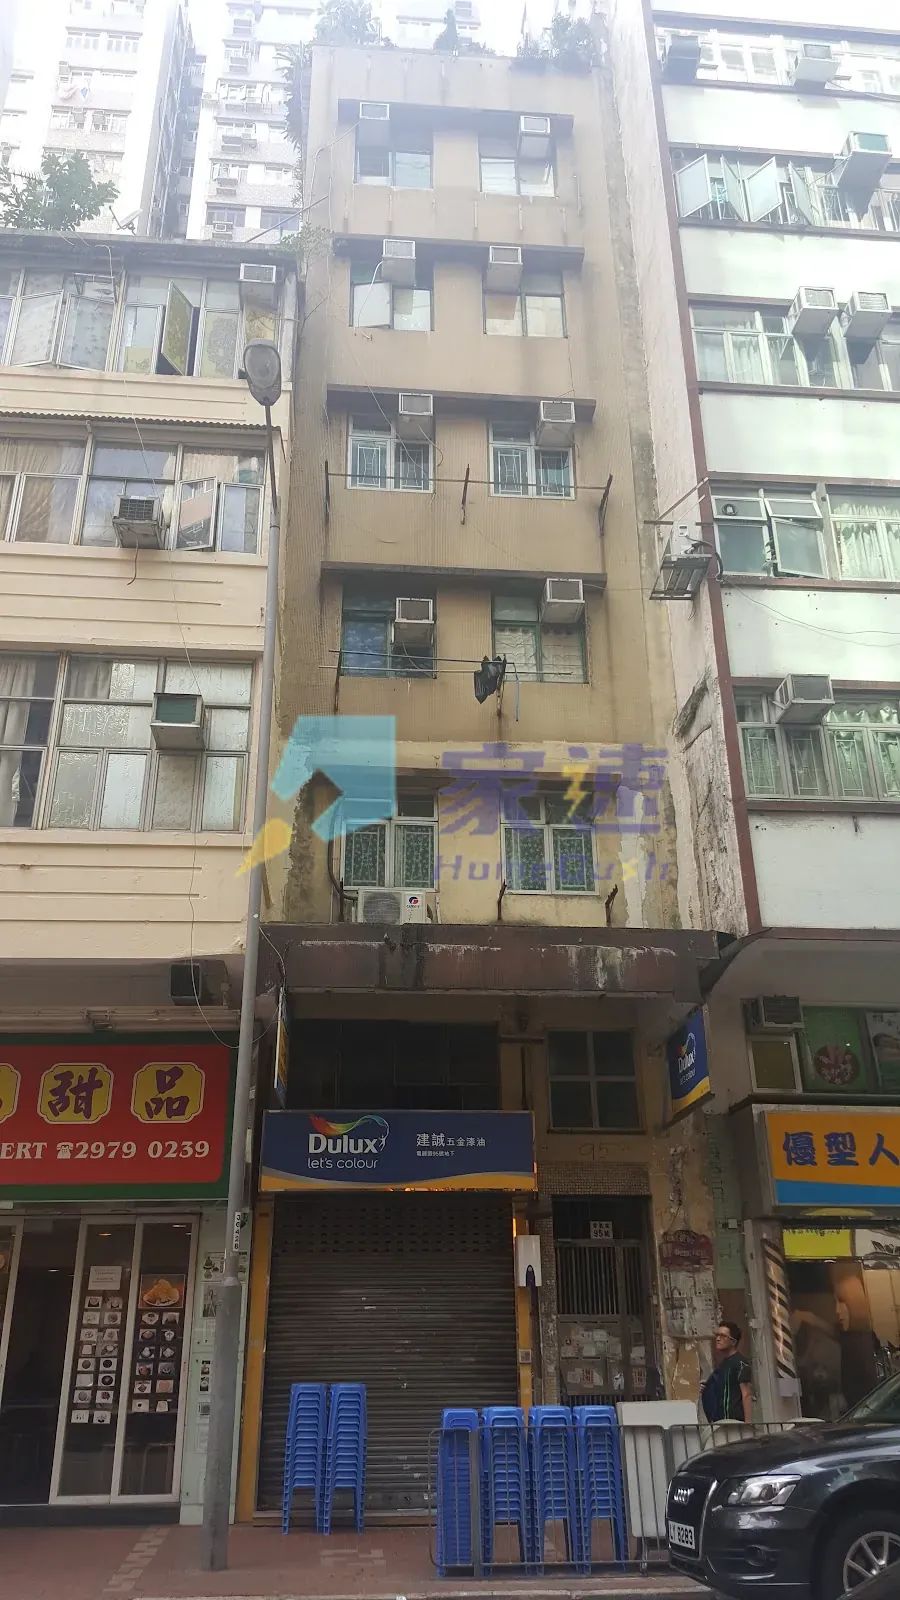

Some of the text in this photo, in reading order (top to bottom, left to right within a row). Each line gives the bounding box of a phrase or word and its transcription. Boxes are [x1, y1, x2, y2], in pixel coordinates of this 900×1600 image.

[0, 1066, 189, 1119] 甜品
[0, 1140, 209, 1159] ERT 2979 0239
[308, 1133, 379, 1154] Dulux
[782, 1131, 900, 1167] 優型人
[307, 1157, 379, 1169] let's colour
